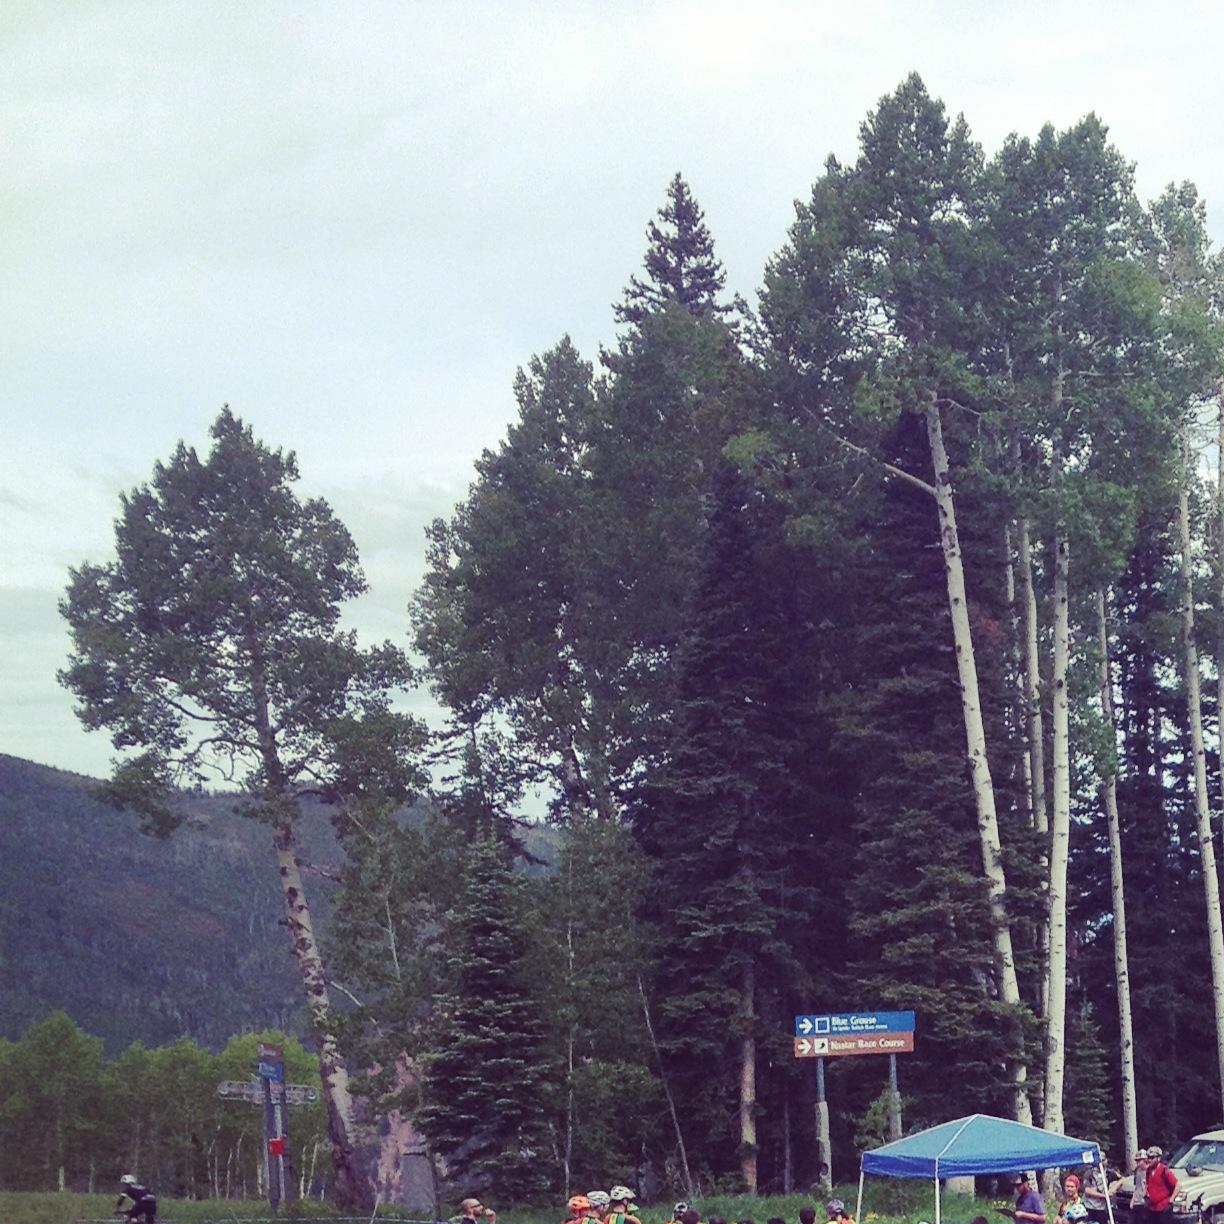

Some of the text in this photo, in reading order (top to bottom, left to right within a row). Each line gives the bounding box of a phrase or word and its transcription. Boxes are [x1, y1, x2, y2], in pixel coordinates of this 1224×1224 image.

[831, 1017, 848, 1025] Blue
[858, 1039, 877, 1049] Race
[879, 1038, 905, 1048] Course
